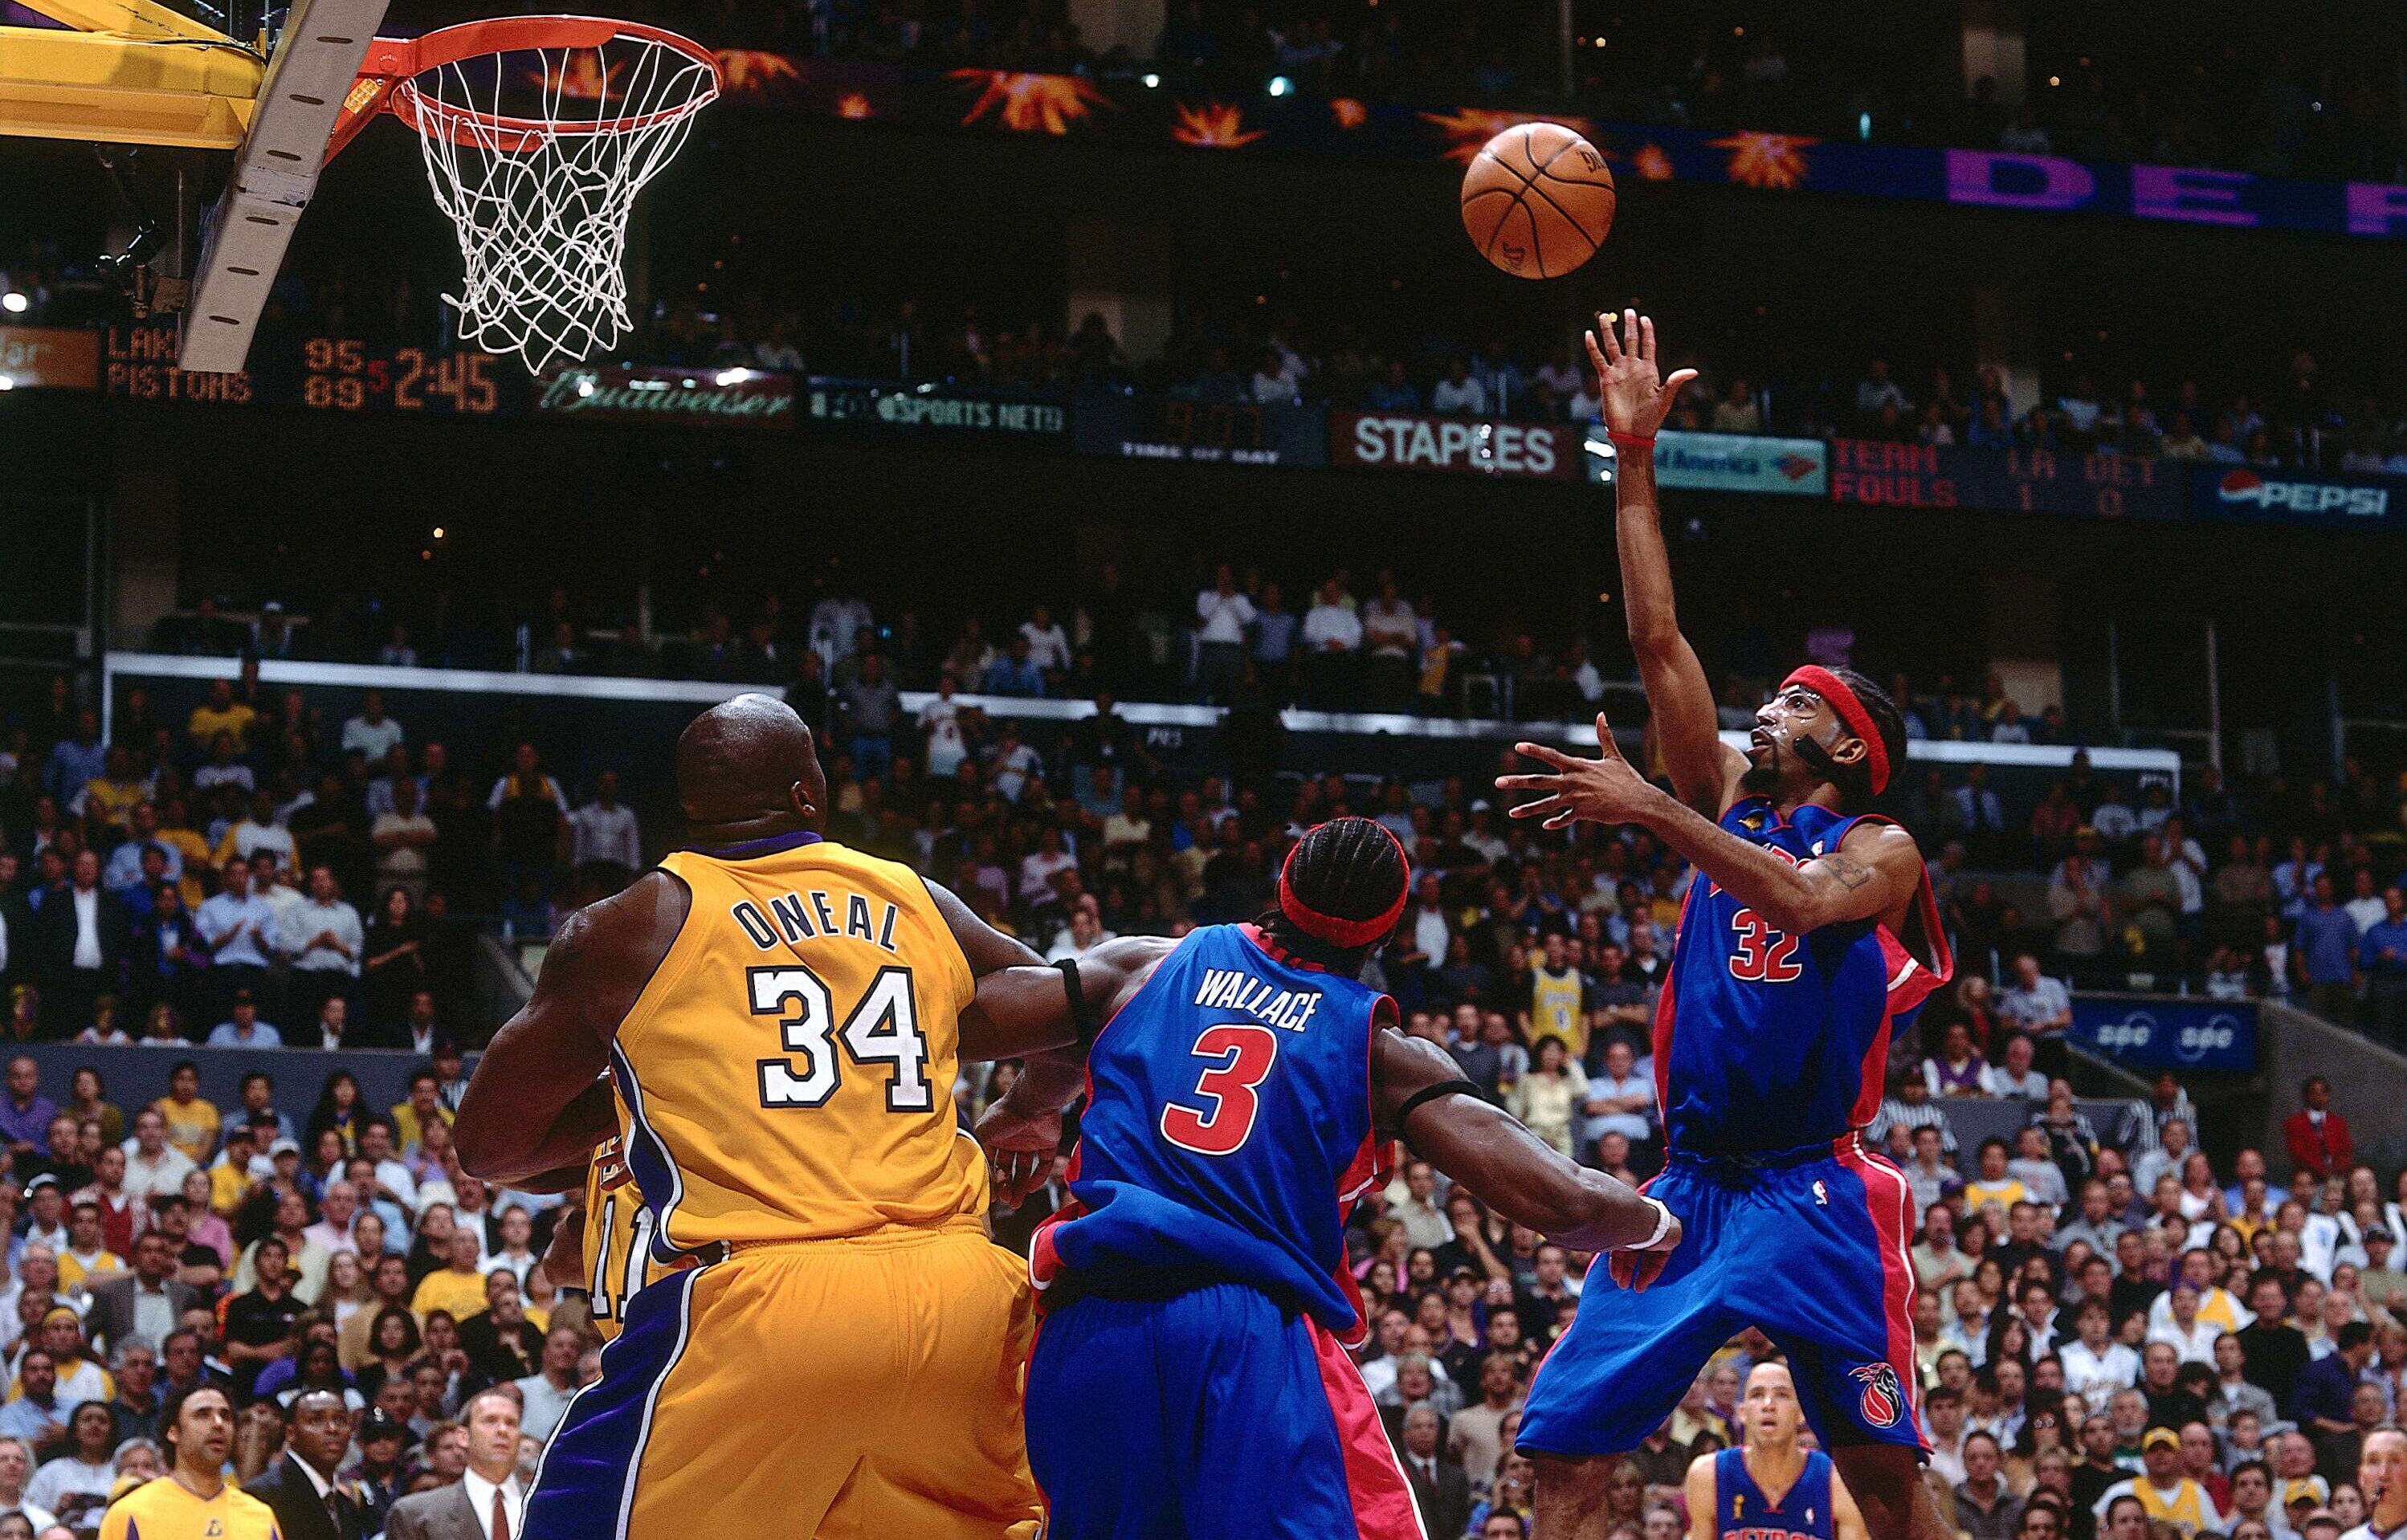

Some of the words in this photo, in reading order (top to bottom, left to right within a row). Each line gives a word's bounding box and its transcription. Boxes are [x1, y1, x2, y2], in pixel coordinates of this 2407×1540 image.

[108, 363, 252, 401] PISTONS
[304, 338, 363, 373] 95
[394, 348, 499, 414] 2:45
[304, 374, 365, 410] 89
[1355, 417, 1556, 473] STAPLES
[1832, 439, 1938, 475] TEAM
[2008, 448, 2056, 479] LA
[2085, 452, 2154, 487] DET
[1832, 471, 1956, 508] FOULS
[2259, 481, 2389, 516] PEPSI
[730, 890, 899, 953] ONEAL
[1729, 907, 1802, 982] 32
[1193, 968, 1323, 1033] WALLACE
[746, 965, 934, 1113] 34
[1160, 1024, 1279, 1156] 3
[589, 1195, 656, 1323] 11
